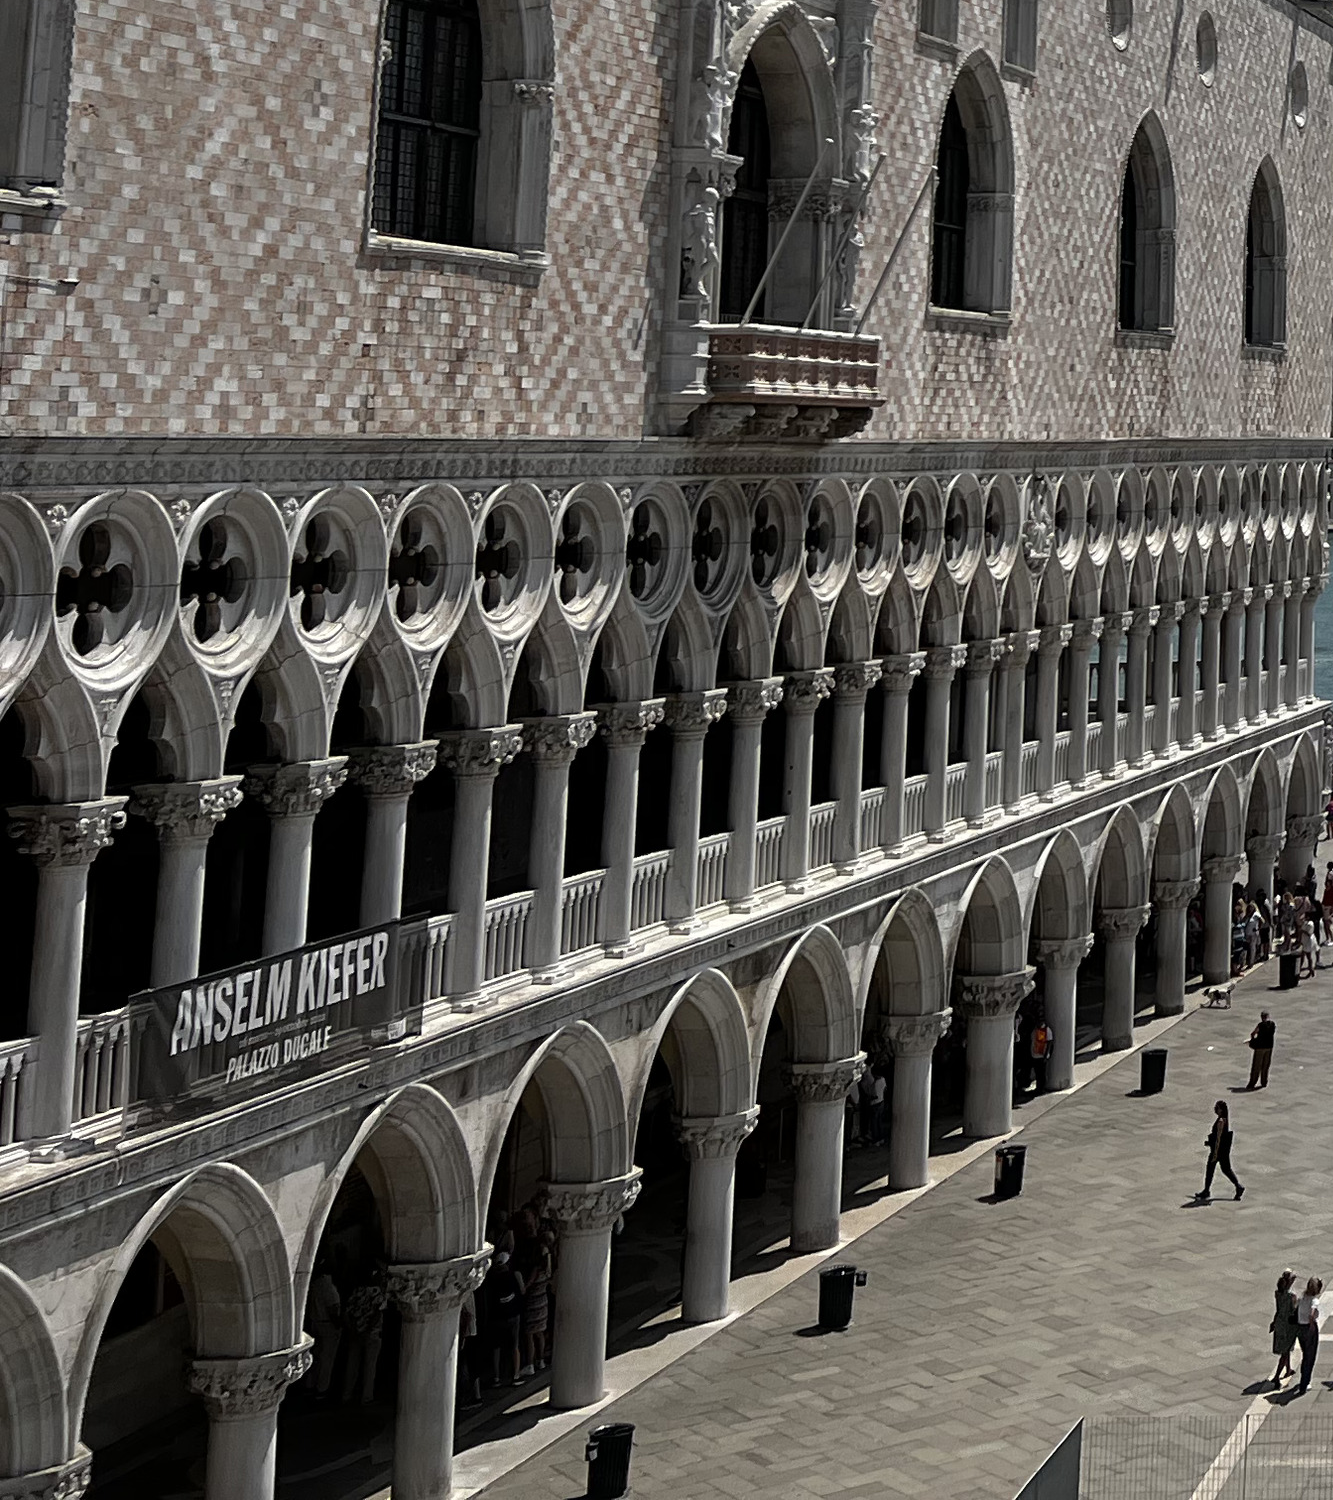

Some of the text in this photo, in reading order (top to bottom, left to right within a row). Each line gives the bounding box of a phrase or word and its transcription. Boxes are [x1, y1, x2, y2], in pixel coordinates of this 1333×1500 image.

[170, 958, 292, 1056] ANSELM
[296, 931, 389, 1015] KIEFER
[225, 1041, 279, 1084] PALAZZO
[283, 1025, 333, 1064] DUCALE
